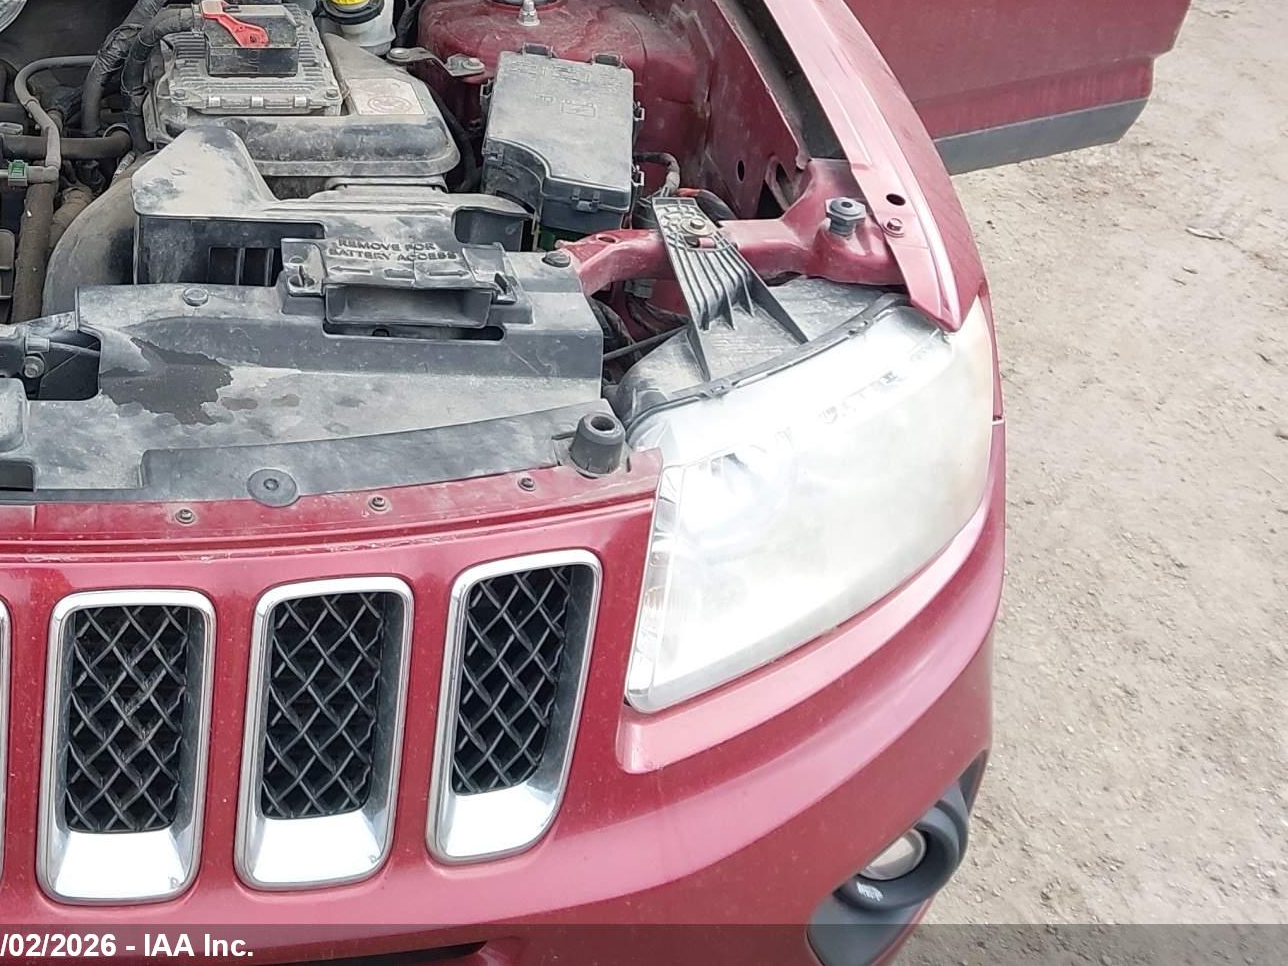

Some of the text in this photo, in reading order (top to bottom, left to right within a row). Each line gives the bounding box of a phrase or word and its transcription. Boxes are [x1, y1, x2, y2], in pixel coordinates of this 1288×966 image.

[338, 237, 437, 252] REMOVE FOR
[328, 248, 458, 262] BATTERY ACCESS
